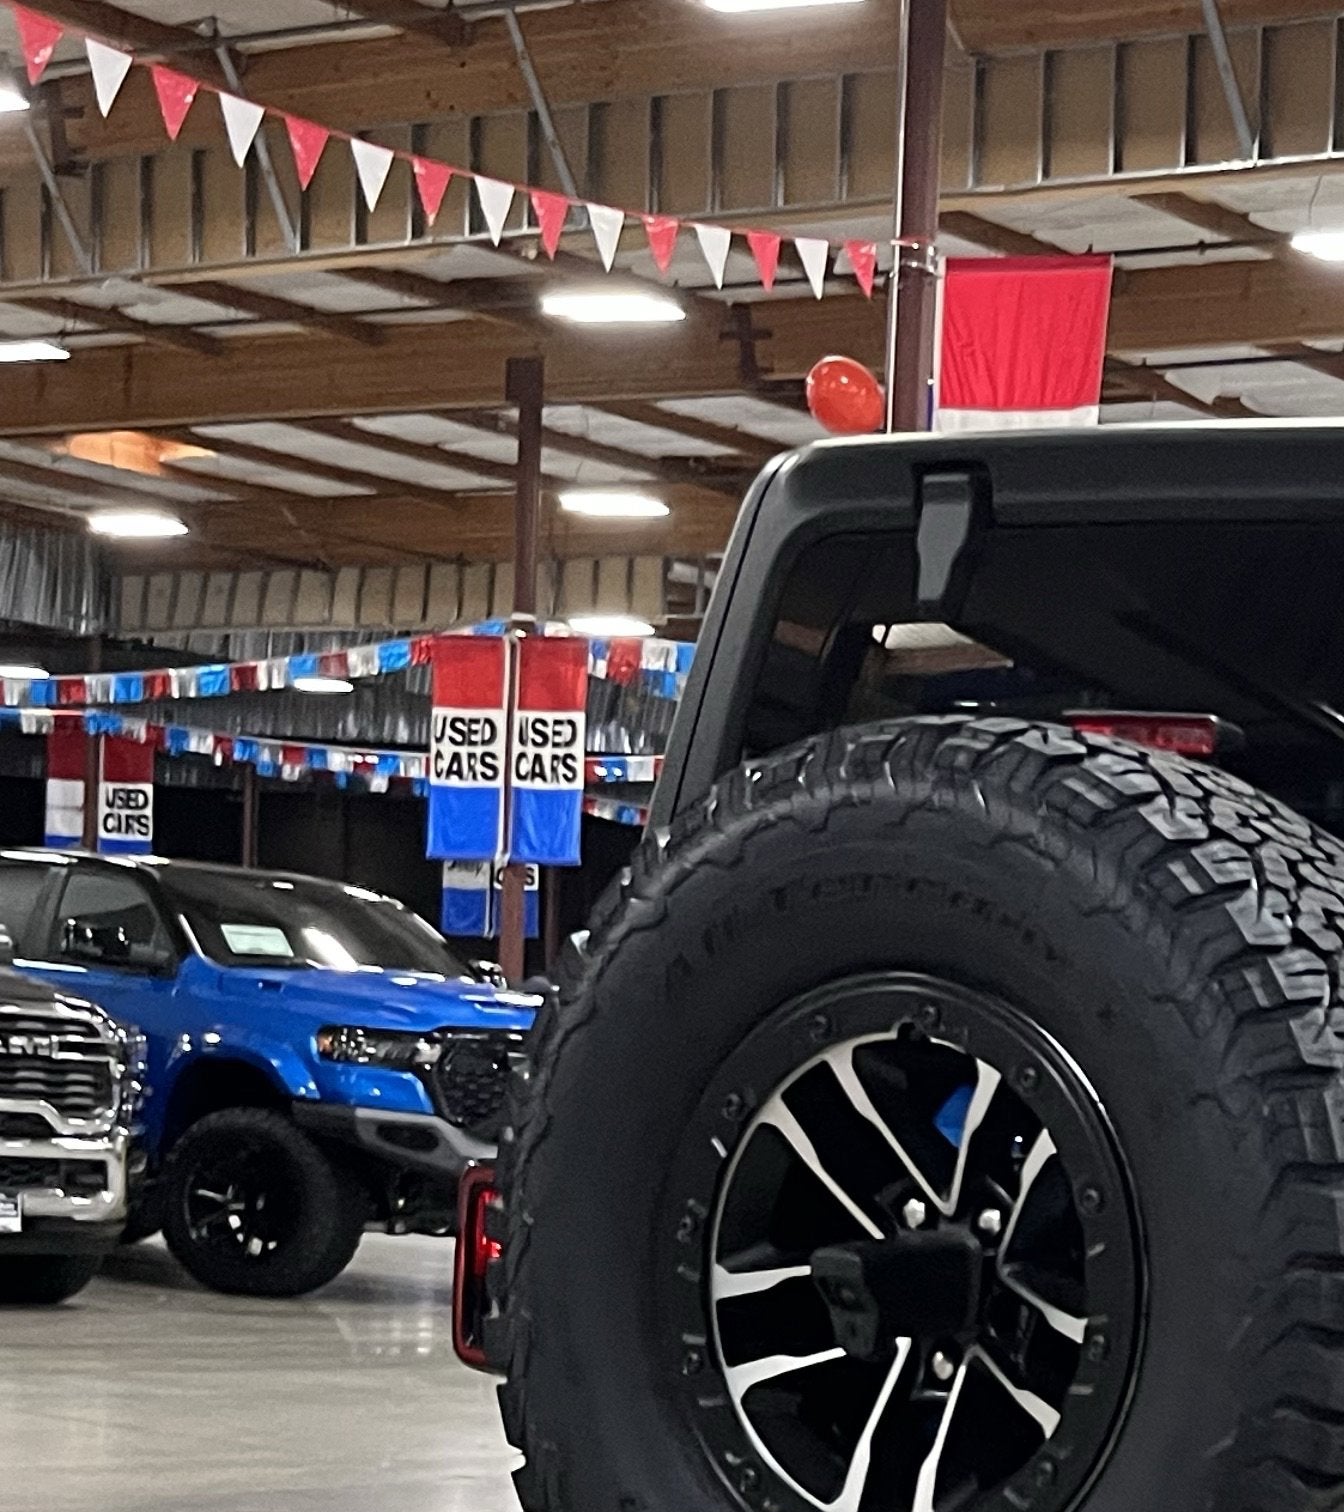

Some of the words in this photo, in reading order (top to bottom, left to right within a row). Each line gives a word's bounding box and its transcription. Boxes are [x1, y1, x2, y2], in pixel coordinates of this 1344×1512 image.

[434, 715, 498, 746] USED
[518, 718, 578, 748] USED
[434, 749, 500, 782] CARS
[515, 752, 578, 784] CARS
[105, 787, 149, 810] USED
[102, 812, 150, 837] CARS
